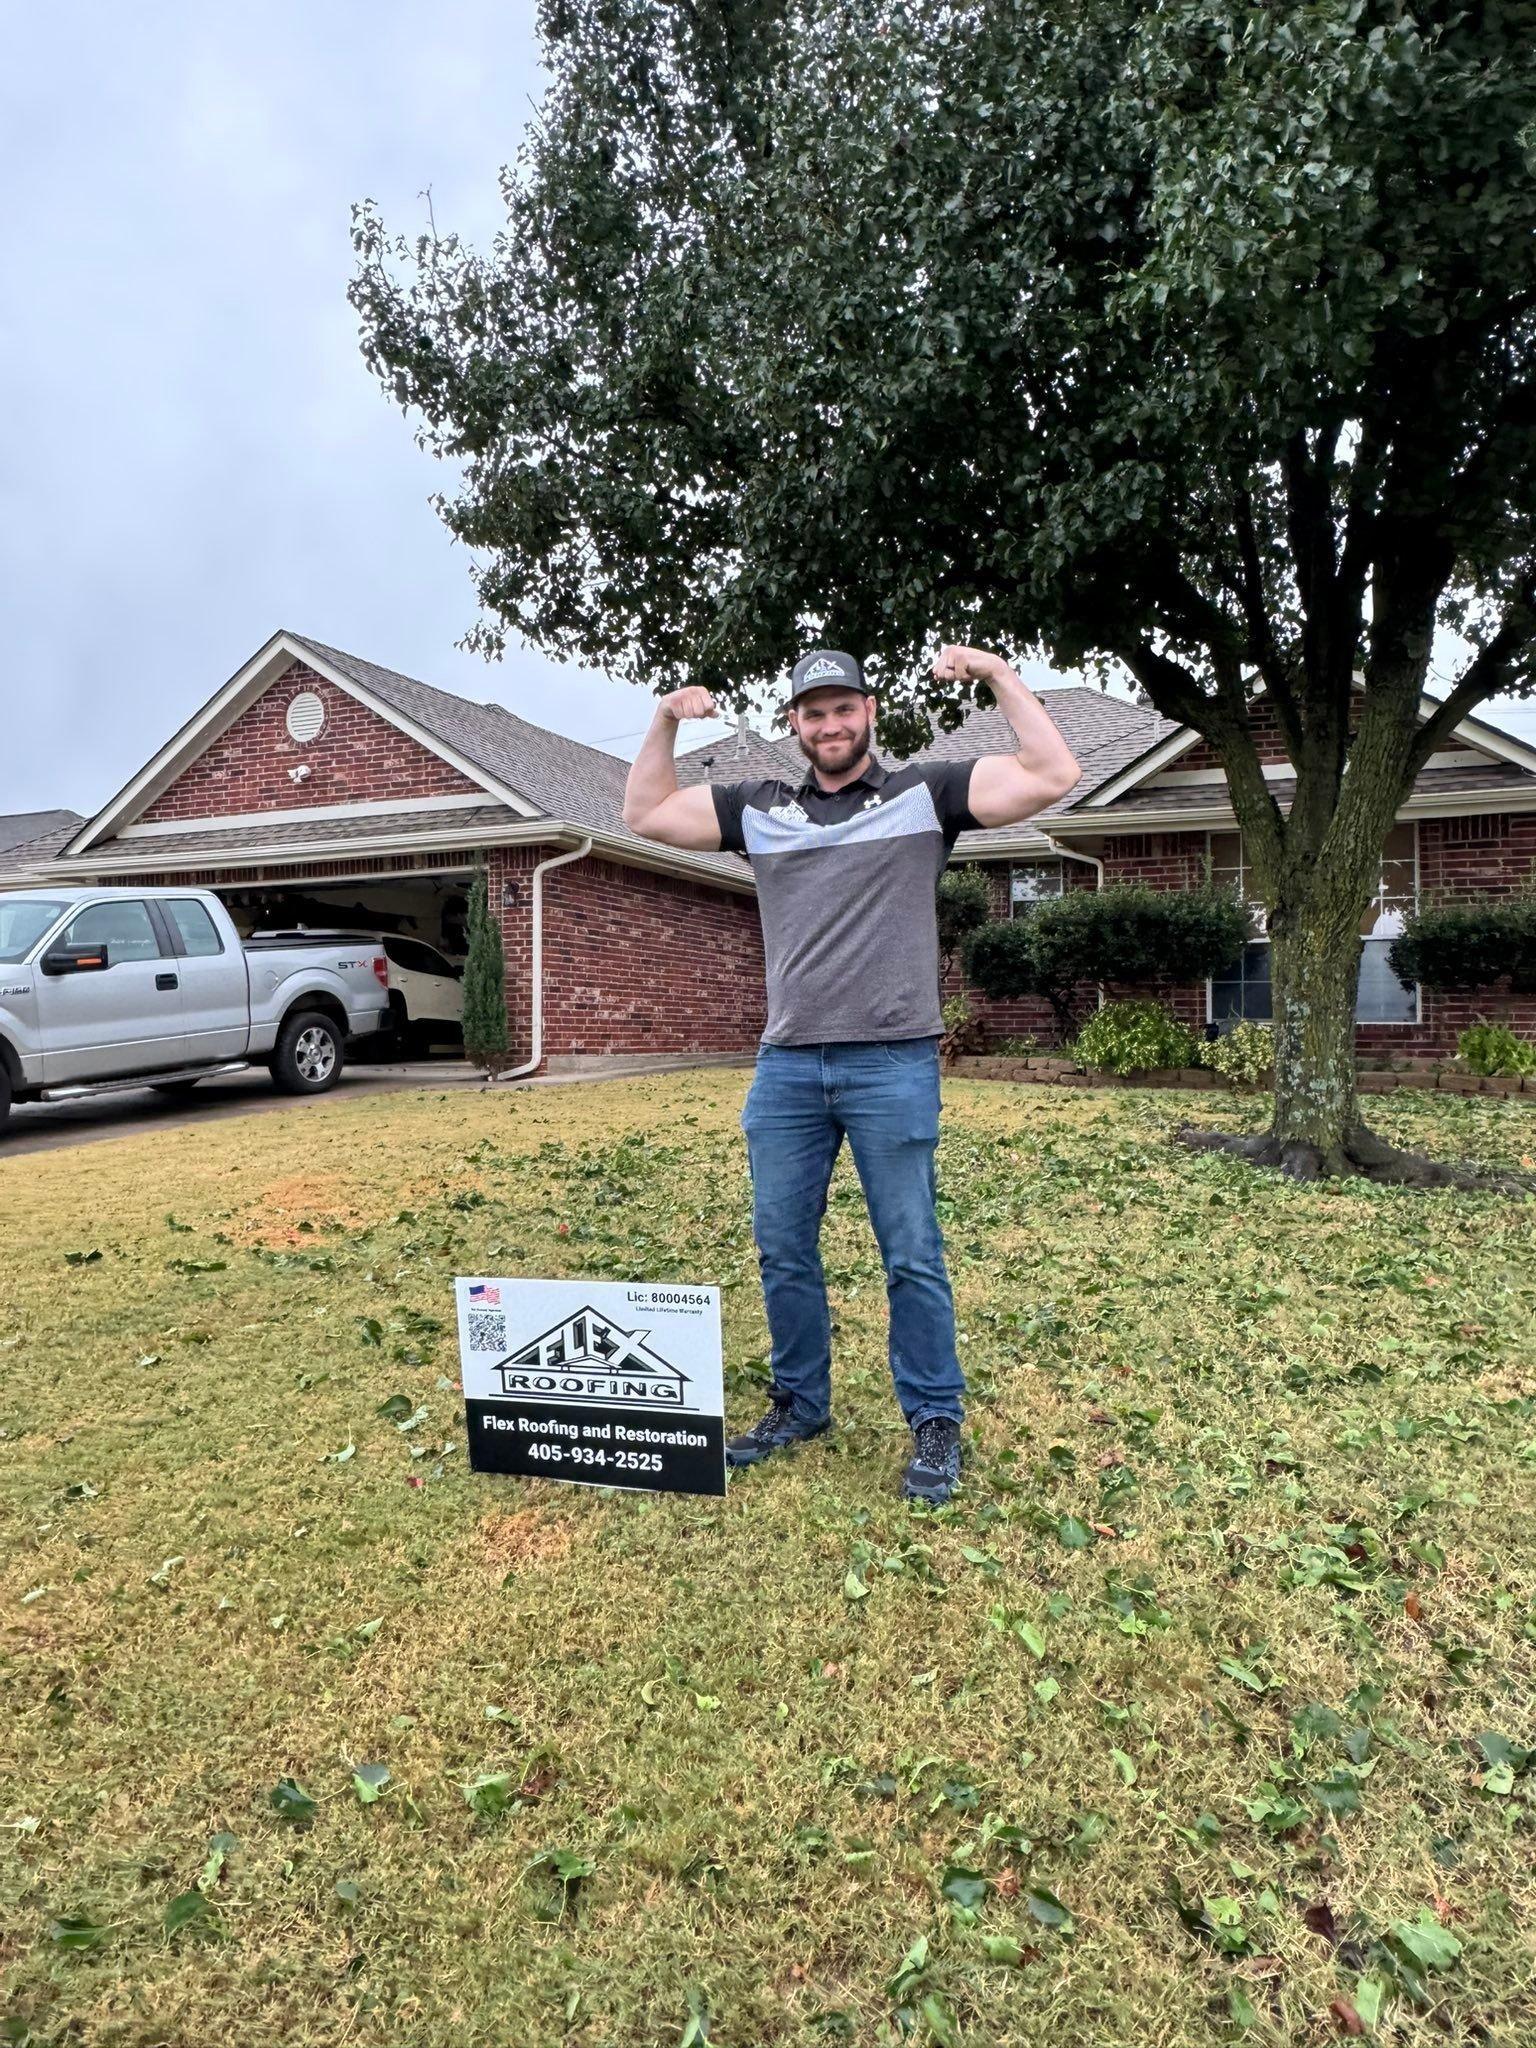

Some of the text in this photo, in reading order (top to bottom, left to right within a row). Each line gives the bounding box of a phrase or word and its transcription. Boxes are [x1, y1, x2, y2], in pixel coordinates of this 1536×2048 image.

[338, 960, 368, 969] STX
[627, 1291, 711, 1305] Lic: 80004564
[508, 1373, 679, 1399] ROOFING
[482, 1415, 708, 1447] Flex Roofing and Restoration
[528, 1443, 664, 1472] 405-934-2525
